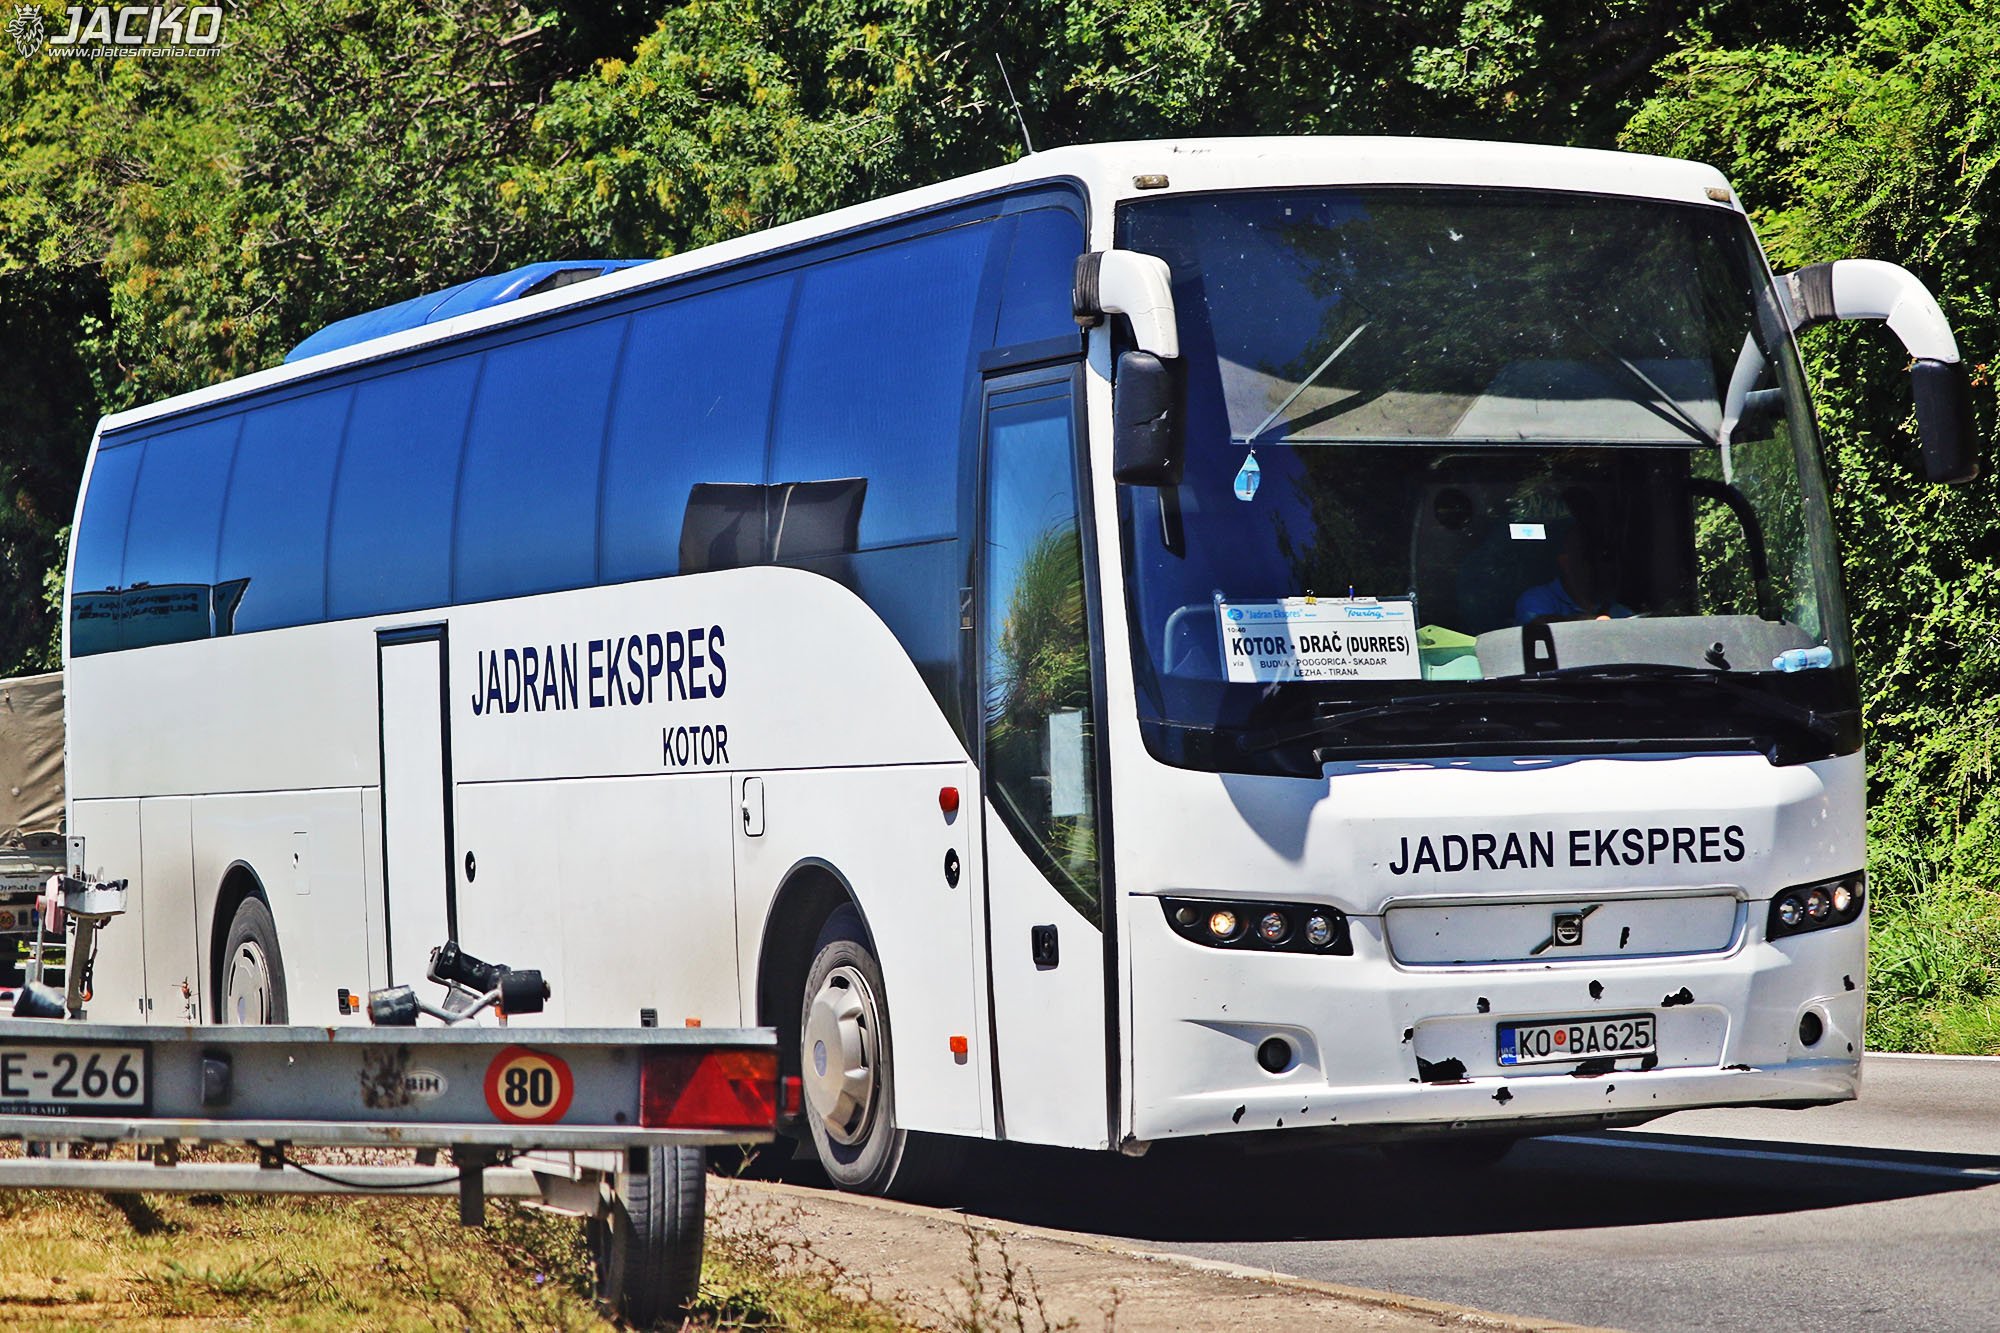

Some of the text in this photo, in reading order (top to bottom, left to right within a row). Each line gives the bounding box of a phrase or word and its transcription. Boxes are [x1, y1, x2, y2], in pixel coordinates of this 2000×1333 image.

[1232, 636, 1287, 656] KOTOR
[1300, 631, 1342, 653] DRAČ
[1346, 635, 1410, 656] (DURRES)
[1260, 660, 1290, 669] BUDVA
[1296, 658, 1347, 667] PODGORICA
[1353, 657, 1387, 666] SKADAR
[472, 625, 727, 716] JADRAN EKSPRES
[1294, 669, 1322, 677] LEZHA
[1329, 668, 1359, 676] TIRANA
[662, 724, 729, 766] KOTOR
[1389, 825, 1746, 875] JADRAN EKSPRES
[1519, 1021, 1650, 1059] KO BA625
[1, 1053, 139, 1098] E-266
[505, 1067, 553, 1108] 80
